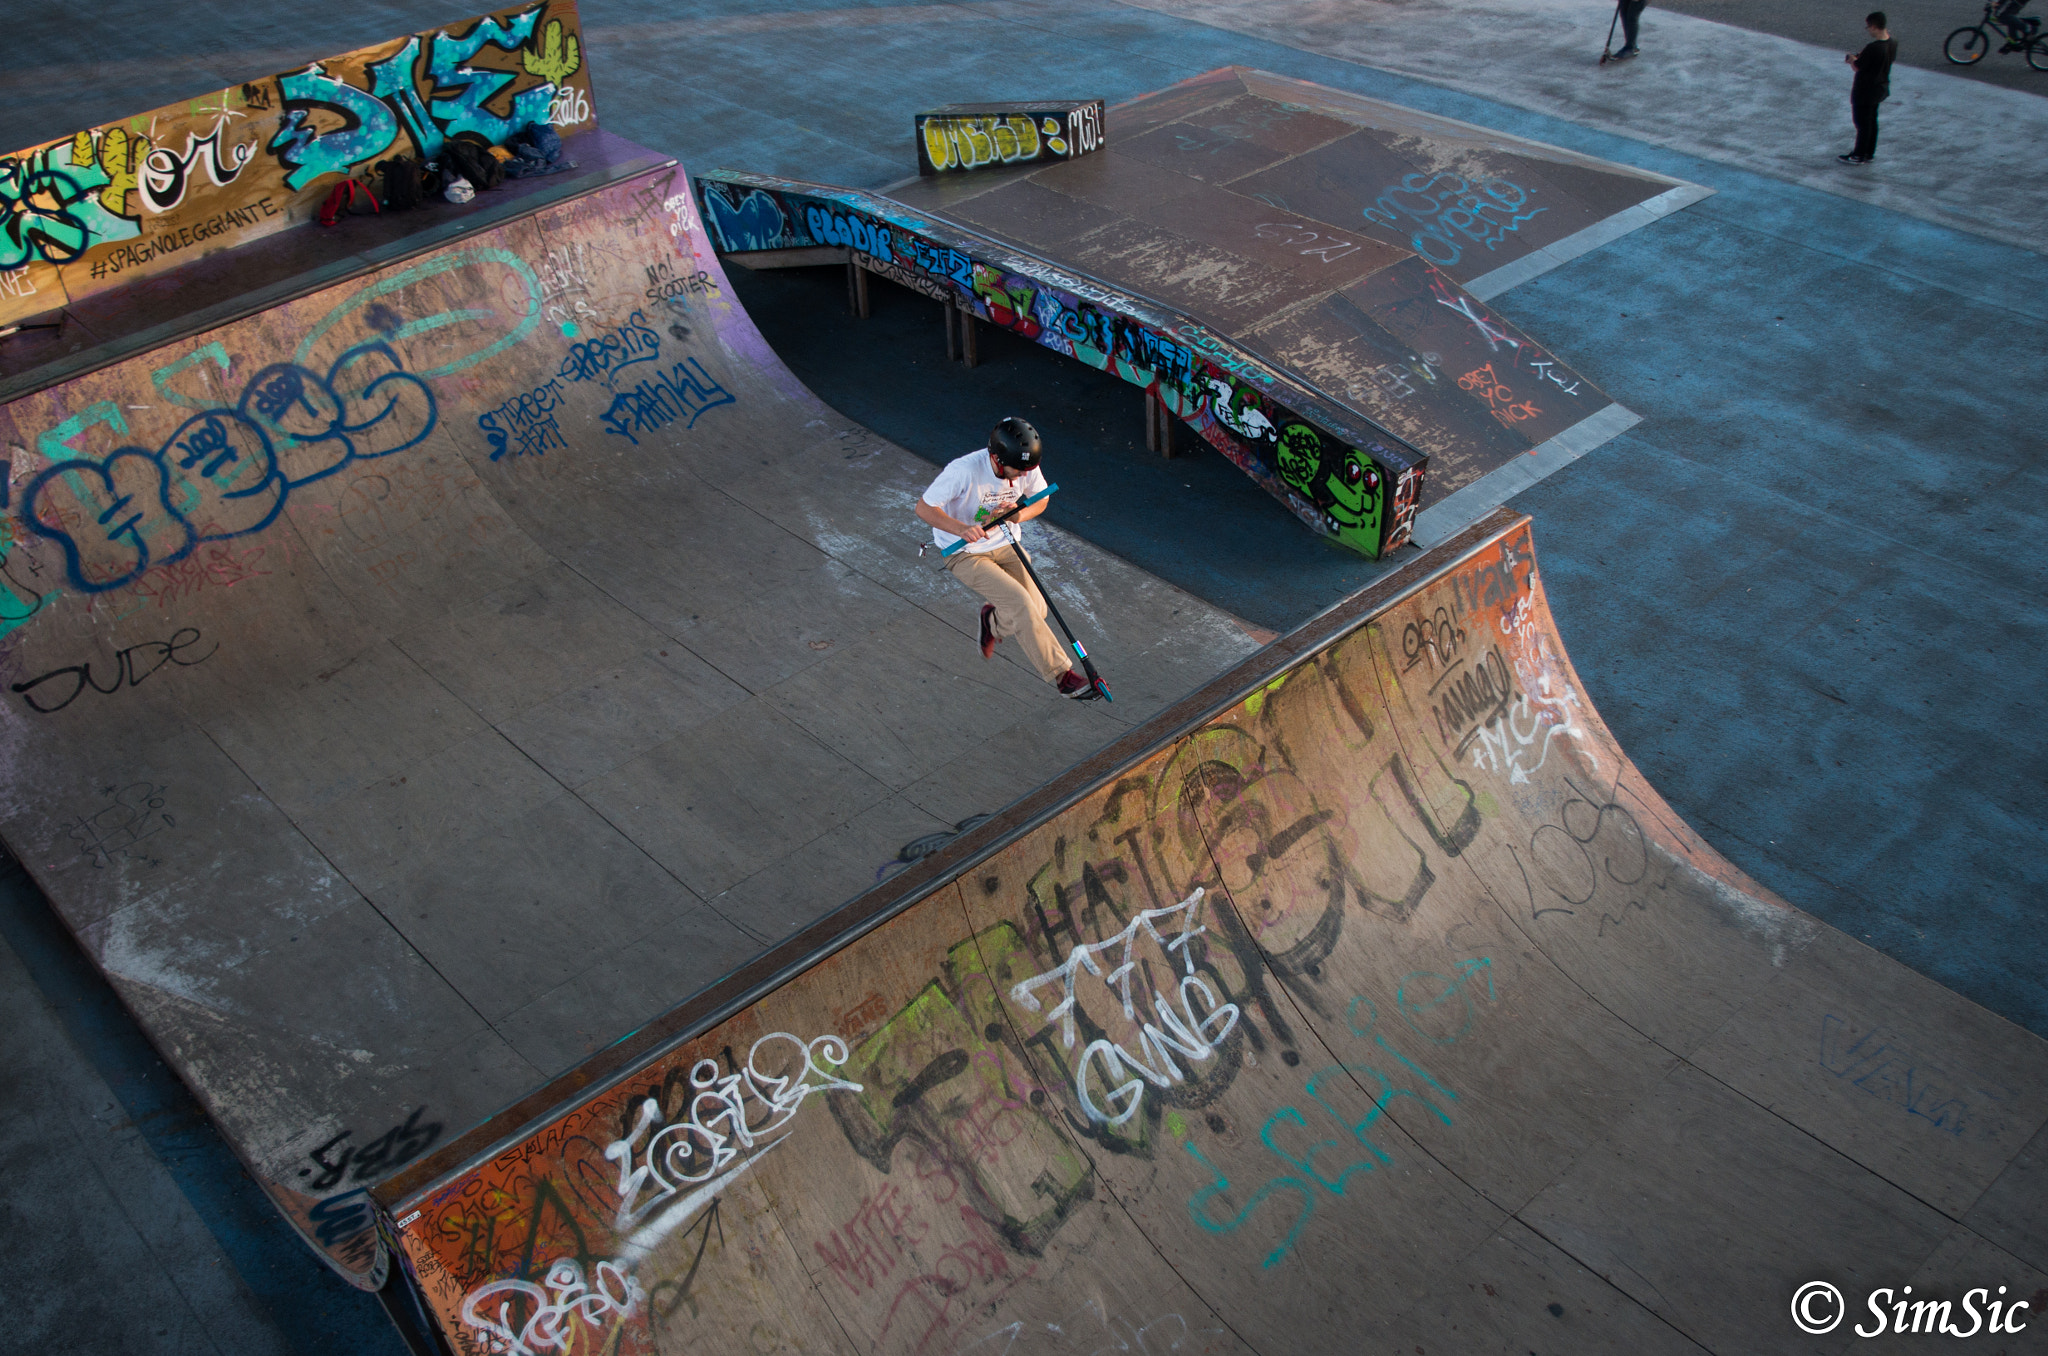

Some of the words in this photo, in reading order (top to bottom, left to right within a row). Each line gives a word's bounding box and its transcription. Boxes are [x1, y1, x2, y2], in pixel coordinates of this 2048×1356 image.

[670, 216, 699, 236] DICK
[674, 206, 688, 221] YO
[647, 253, 675, 286] NO!
[646, 270, 717, 306] SCOOTER
[1457, 361, 1498, 391] OBEY
[1480, 385, 1513, 409] YO
